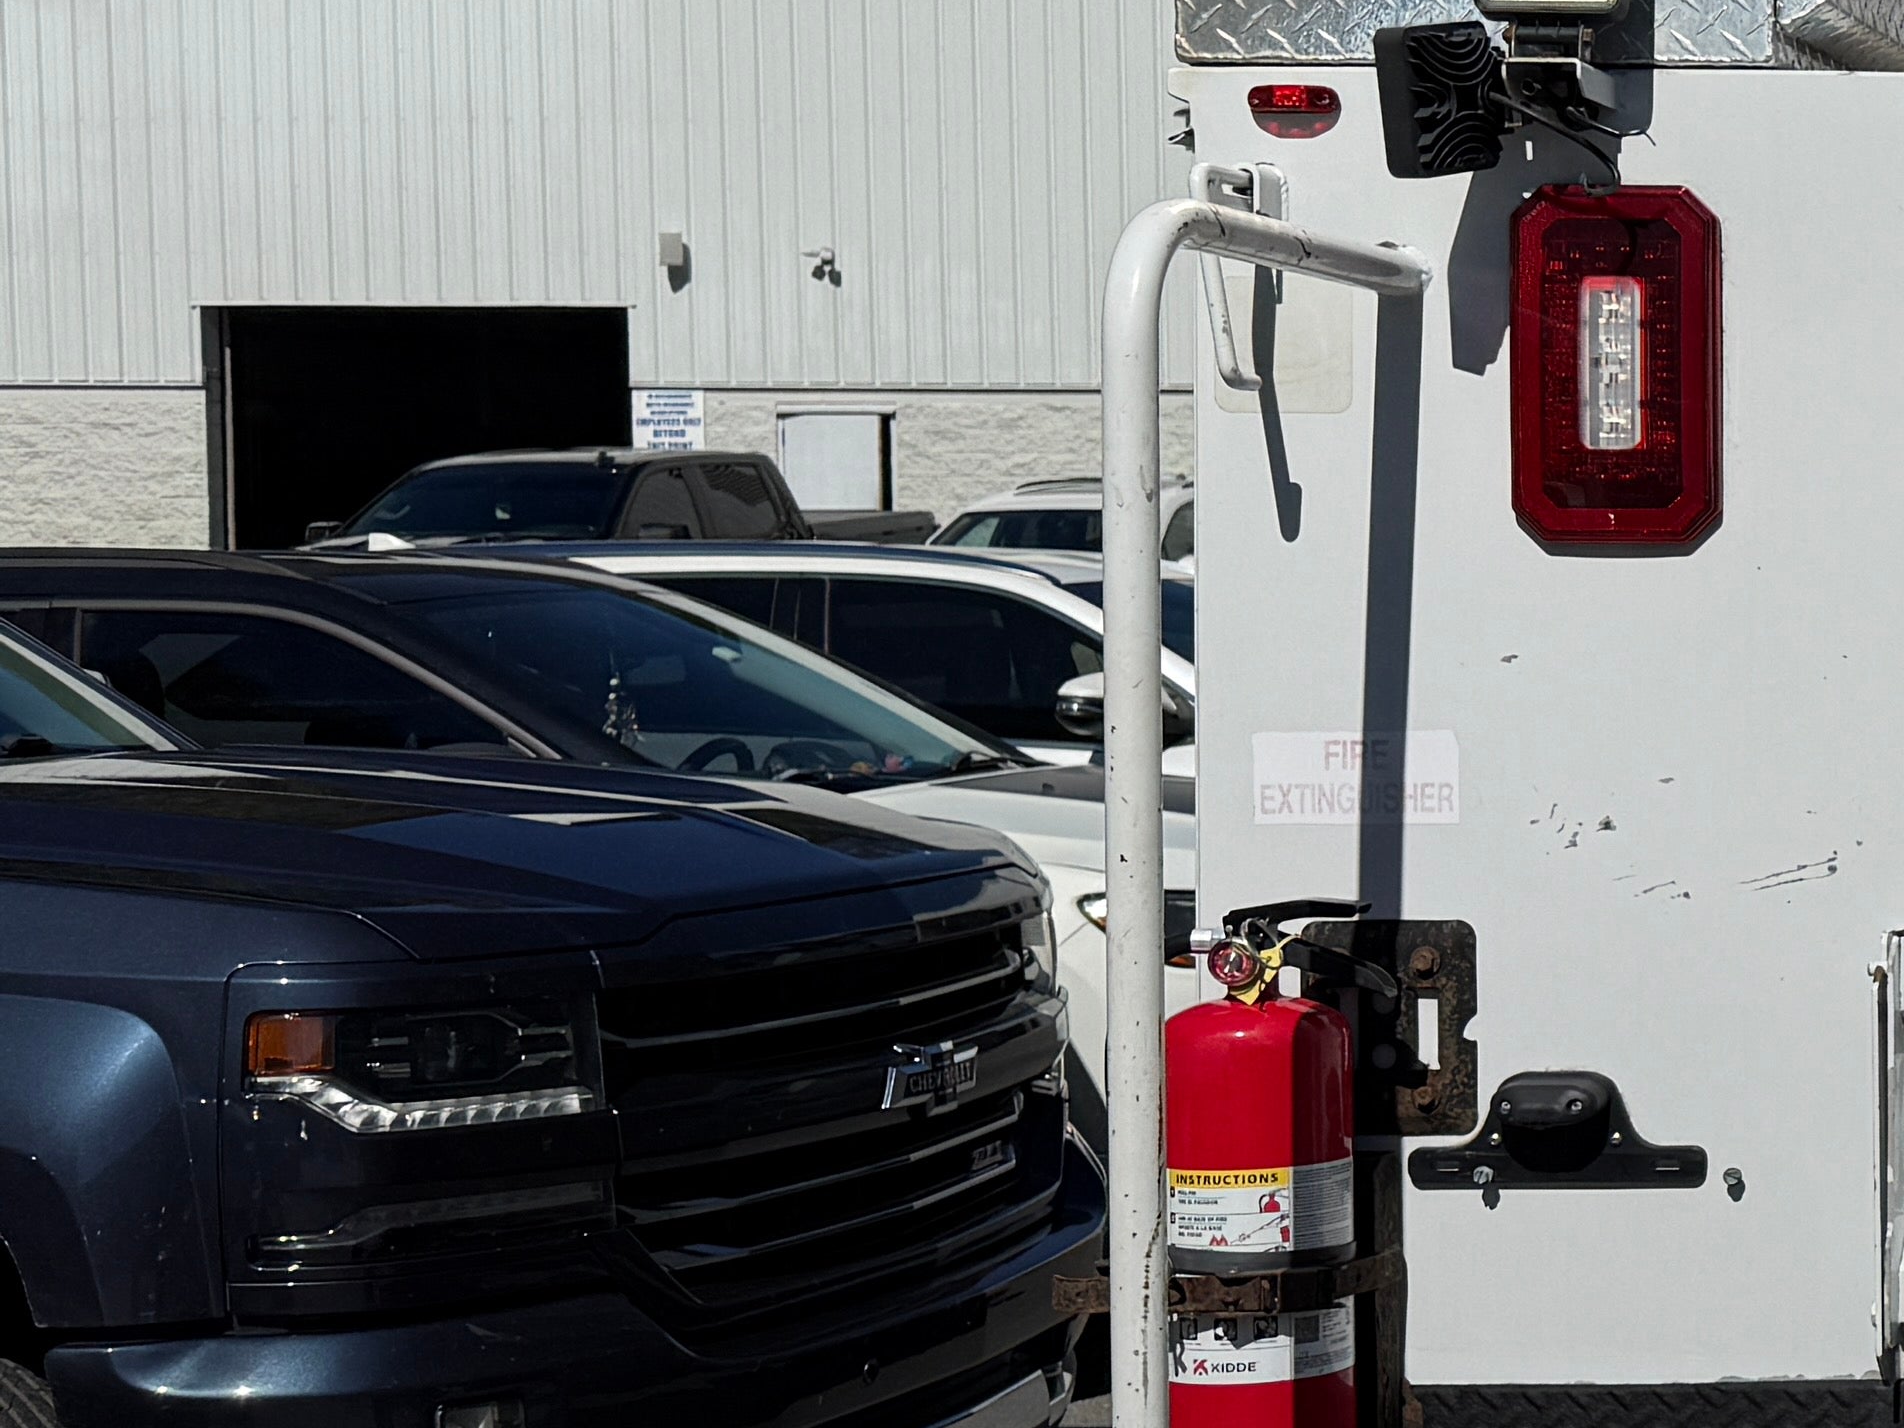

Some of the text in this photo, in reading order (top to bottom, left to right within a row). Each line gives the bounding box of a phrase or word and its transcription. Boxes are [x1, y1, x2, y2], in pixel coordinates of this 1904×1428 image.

[1323, 739, 1390, 771] FIRE
[1259, 782, 1455, 815] EXTINGUISHER
[1175, 1172, 1279, 1185] INSTRUCTIONS
